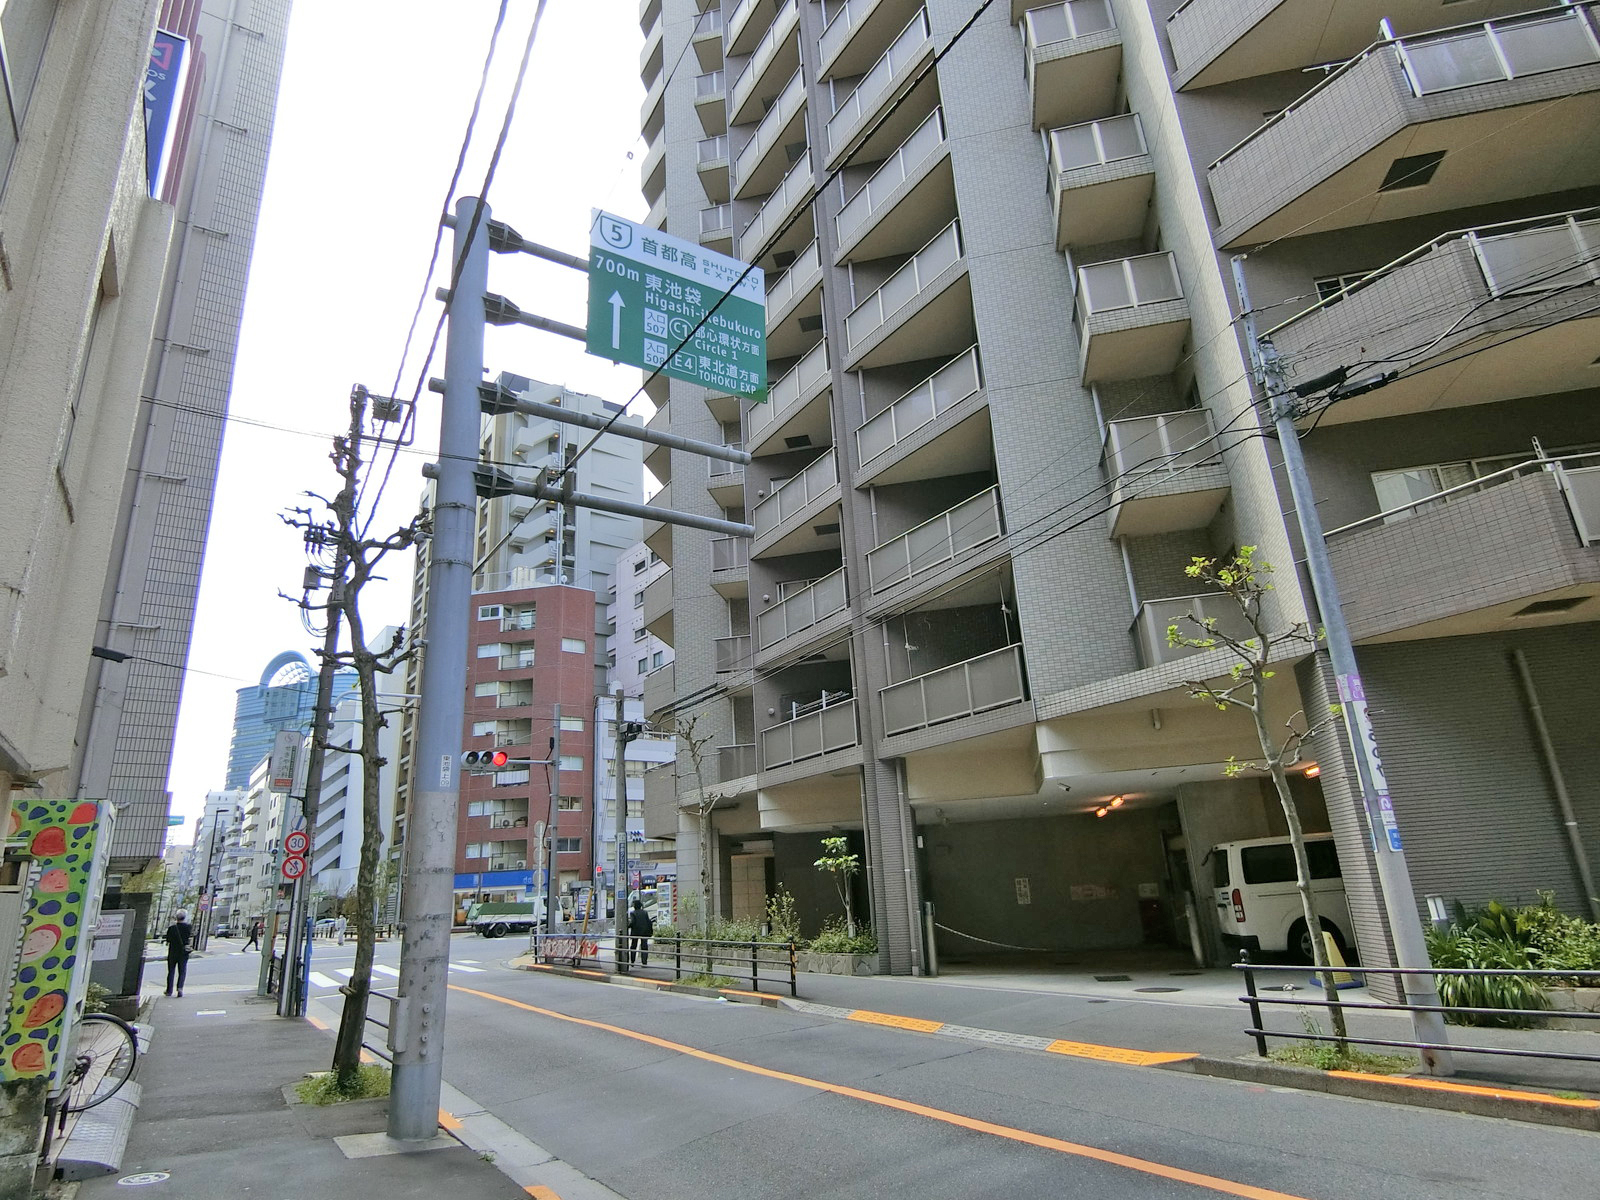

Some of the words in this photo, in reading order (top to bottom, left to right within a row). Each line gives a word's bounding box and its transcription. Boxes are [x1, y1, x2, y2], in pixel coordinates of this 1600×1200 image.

[611, 224, 623, 242] 5
[641, 237, 697, 271] 首都高
[595, 254, 640, 282] 700m
[702, 259, 759, 285] SHUTOKO
[644, 273, 702, 306] 東池袋
[645, 292, 761, 340] Higashi-ikebukuro
[647, 311, 666, 324] 入口
[646, 323, 666, 335] 507
[673, 322, 690, 339] C1
[646, 342, 666, 355] 入口
[694, 325, 760, 357] 都心環状方面
[695, 339, 728, 357] Circle
[731, 350, 738, 361] 1
[646, 354, 666, 365] 508
[674, 356, 693, 370] E4
[698, 356, 760, 385] 東北道方面
[699, 370, 738, 389] TOHOKU
[740, 382, 757, 395] EXP
[290, 837, 305, 848] 30
